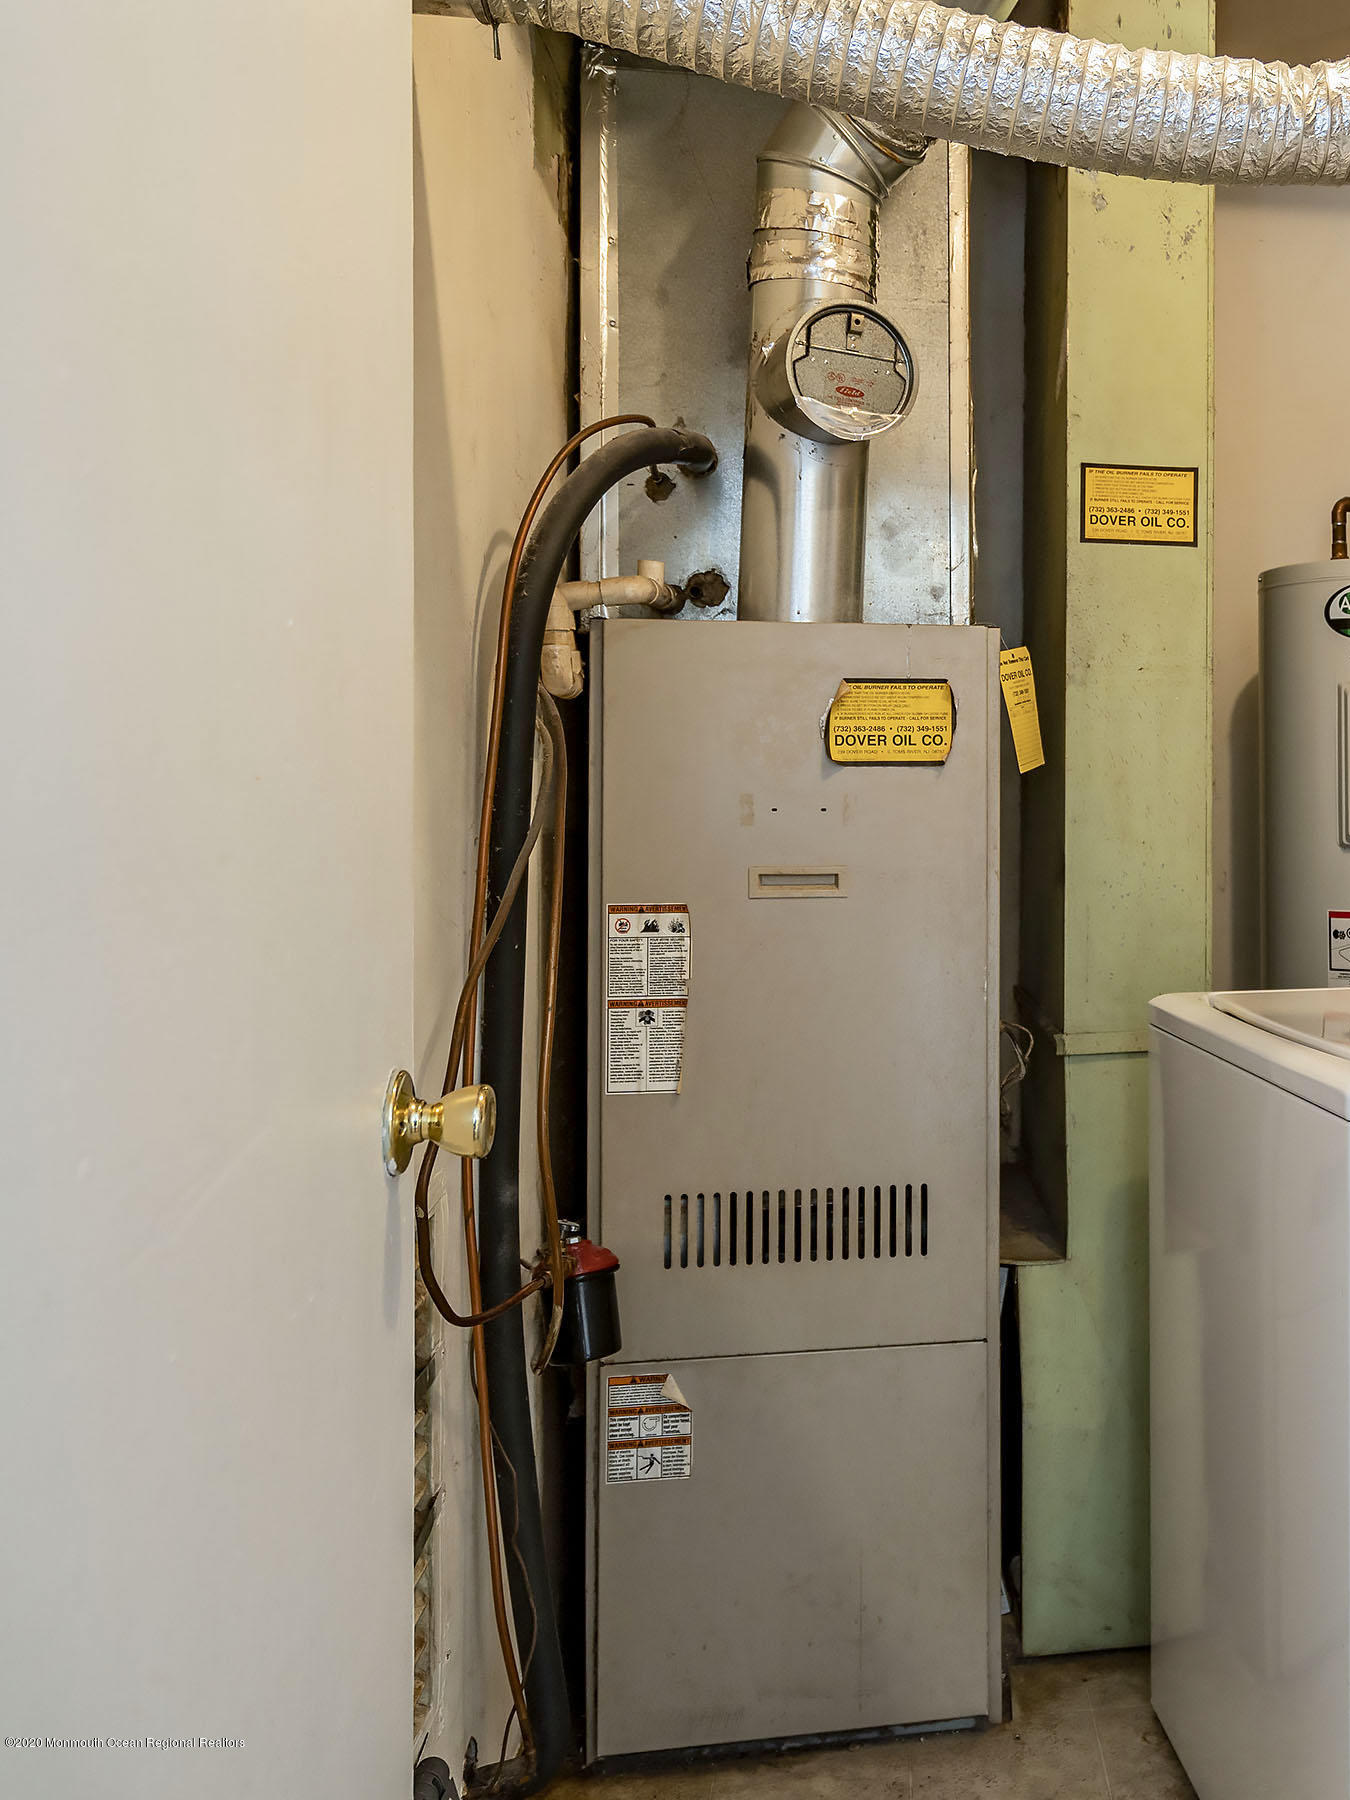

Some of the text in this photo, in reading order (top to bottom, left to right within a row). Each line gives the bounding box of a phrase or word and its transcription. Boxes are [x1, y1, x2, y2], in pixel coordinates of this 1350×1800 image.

[1088, 506, 1105, 514] (732)
[1144, 508, 1161, 516] (732)
[1089, 514, 1190, 529] DOVER OIL CO.
[1001, 671, 1017, 682] DOVER
[1017, 670, 1025, 679] OIL
[833, 725, 851, 733] (732)
[896, 725, 915, 733] (732)
[834, 734, 948, 746] DOVER OIL CO.
